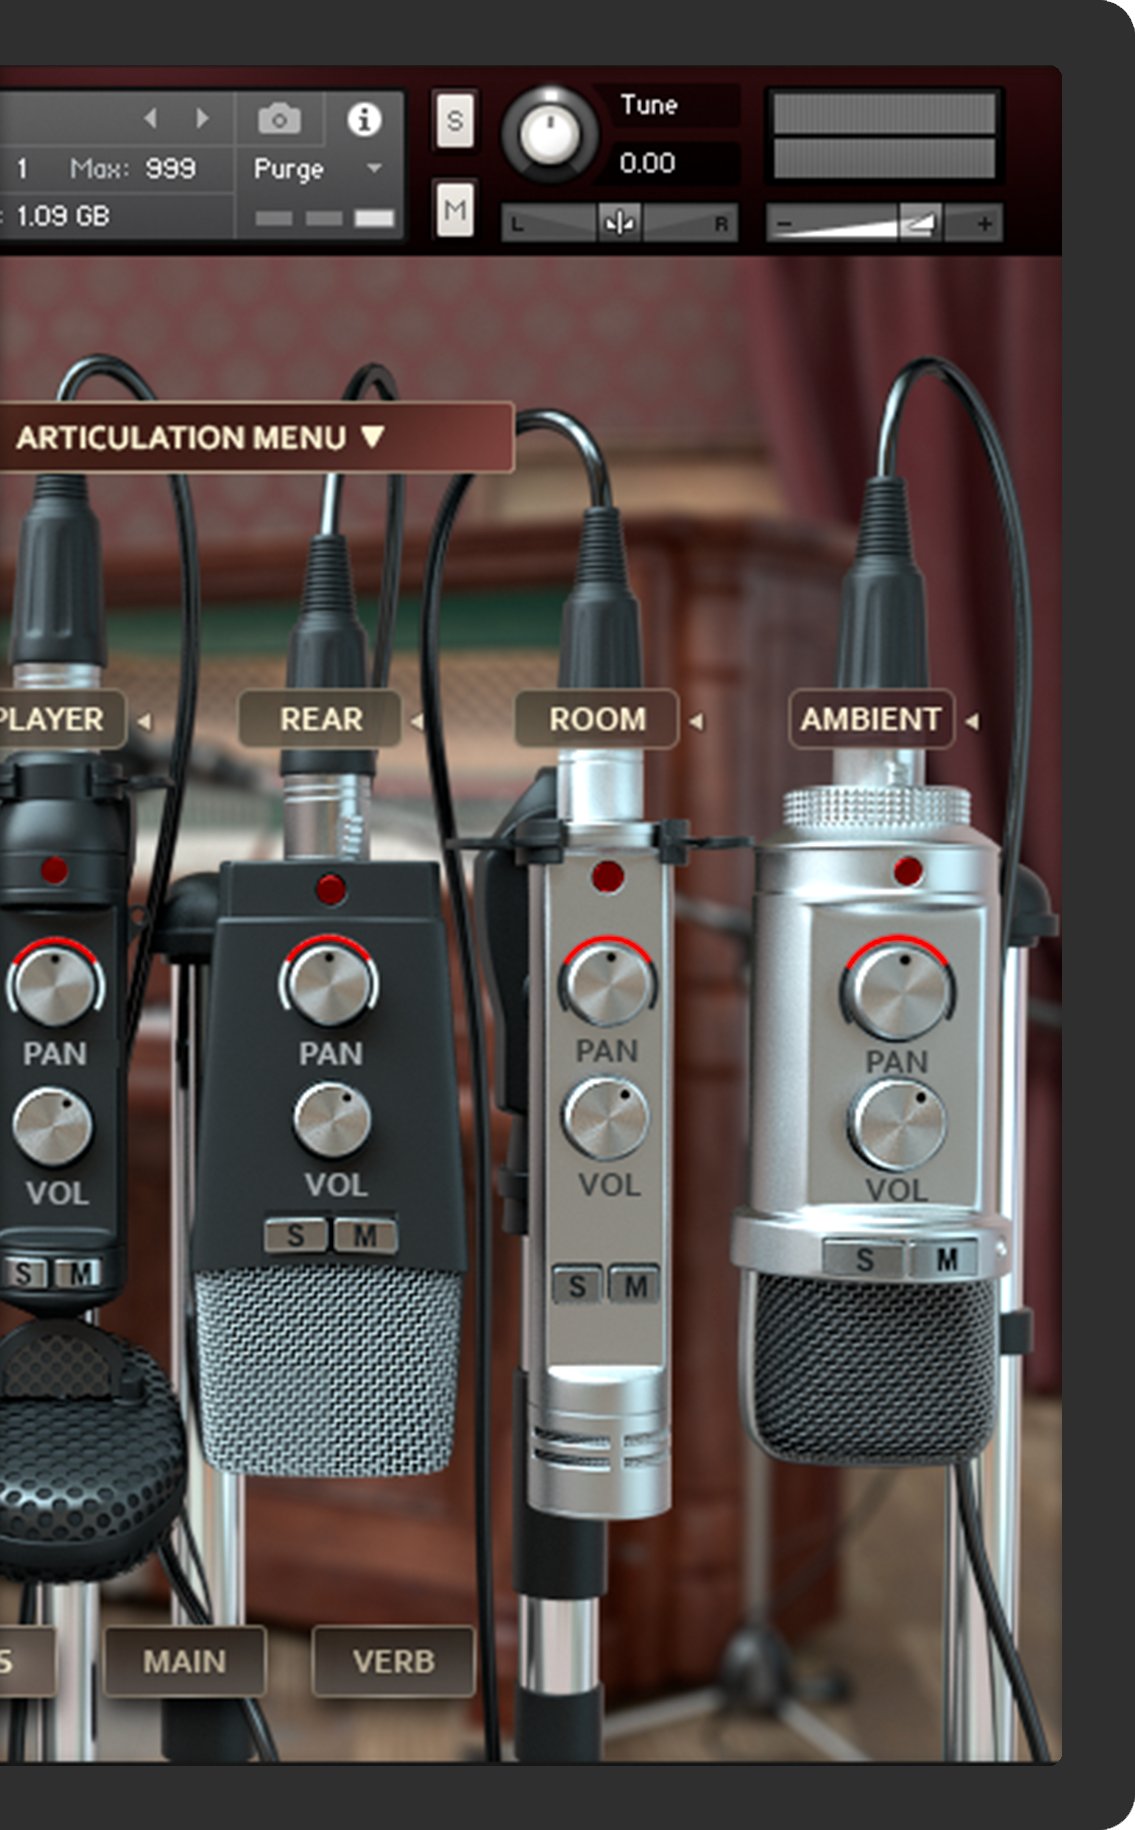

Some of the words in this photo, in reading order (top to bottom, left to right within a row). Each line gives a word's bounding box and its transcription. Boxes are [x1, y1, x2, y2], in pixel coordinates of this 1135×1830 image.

[621, 95, 678, 115] Tune
[447, 110, 462, 131] S
[17, 157, 27, 179] 1
[71, 158, 129, 179] Max:
[146, 157, 197, 179] 999
[254, 158, 324, 184] Purge
[620, 152, 676, 174] 0.00
[17, 205, 68, 226] 1.09
[76, 205, 110, 226] GB
[445, 200, 466, 221] M
[511, 216, 524, 232] L
[715, 216, 728, 233] R
[16, 425, 245, 450] ARTICULATION
[253, 425, 347, 451] MENU
[280, 707, 363, 731] REAR
[549, 707, 646, 731] ROOM
[801, 707, 942, 731] AMBIENT
[24, 1042, 87, 1065] PAN
[300, 1042, 363, 1065] PAN
[577, 1040, 638, 1062] PAN
[867, 1051, 928, 1073] PAN
[26, 1181, 90, 1205] VOL
[305, 1173, 369, 1197] VOL
[578, 1173, 642, 1197] VOL
[866, 1179, 929, 1202] VOL
[288, 1225, 304, 1247] S
[354, 1225, 377, 1246] M
[857, 1249, 874, 1271] S
[937, 1249, 958, 1270] M
[16, 1263, 32, 1285] S
[70, 1263, 92, 1284] M
[569, 1276, 586, 1298] S
[625, 1276, 648, 1297] M
[143, 1650, 226, 1673] MAIN
[353, 1650, 435, 1673] VERB
